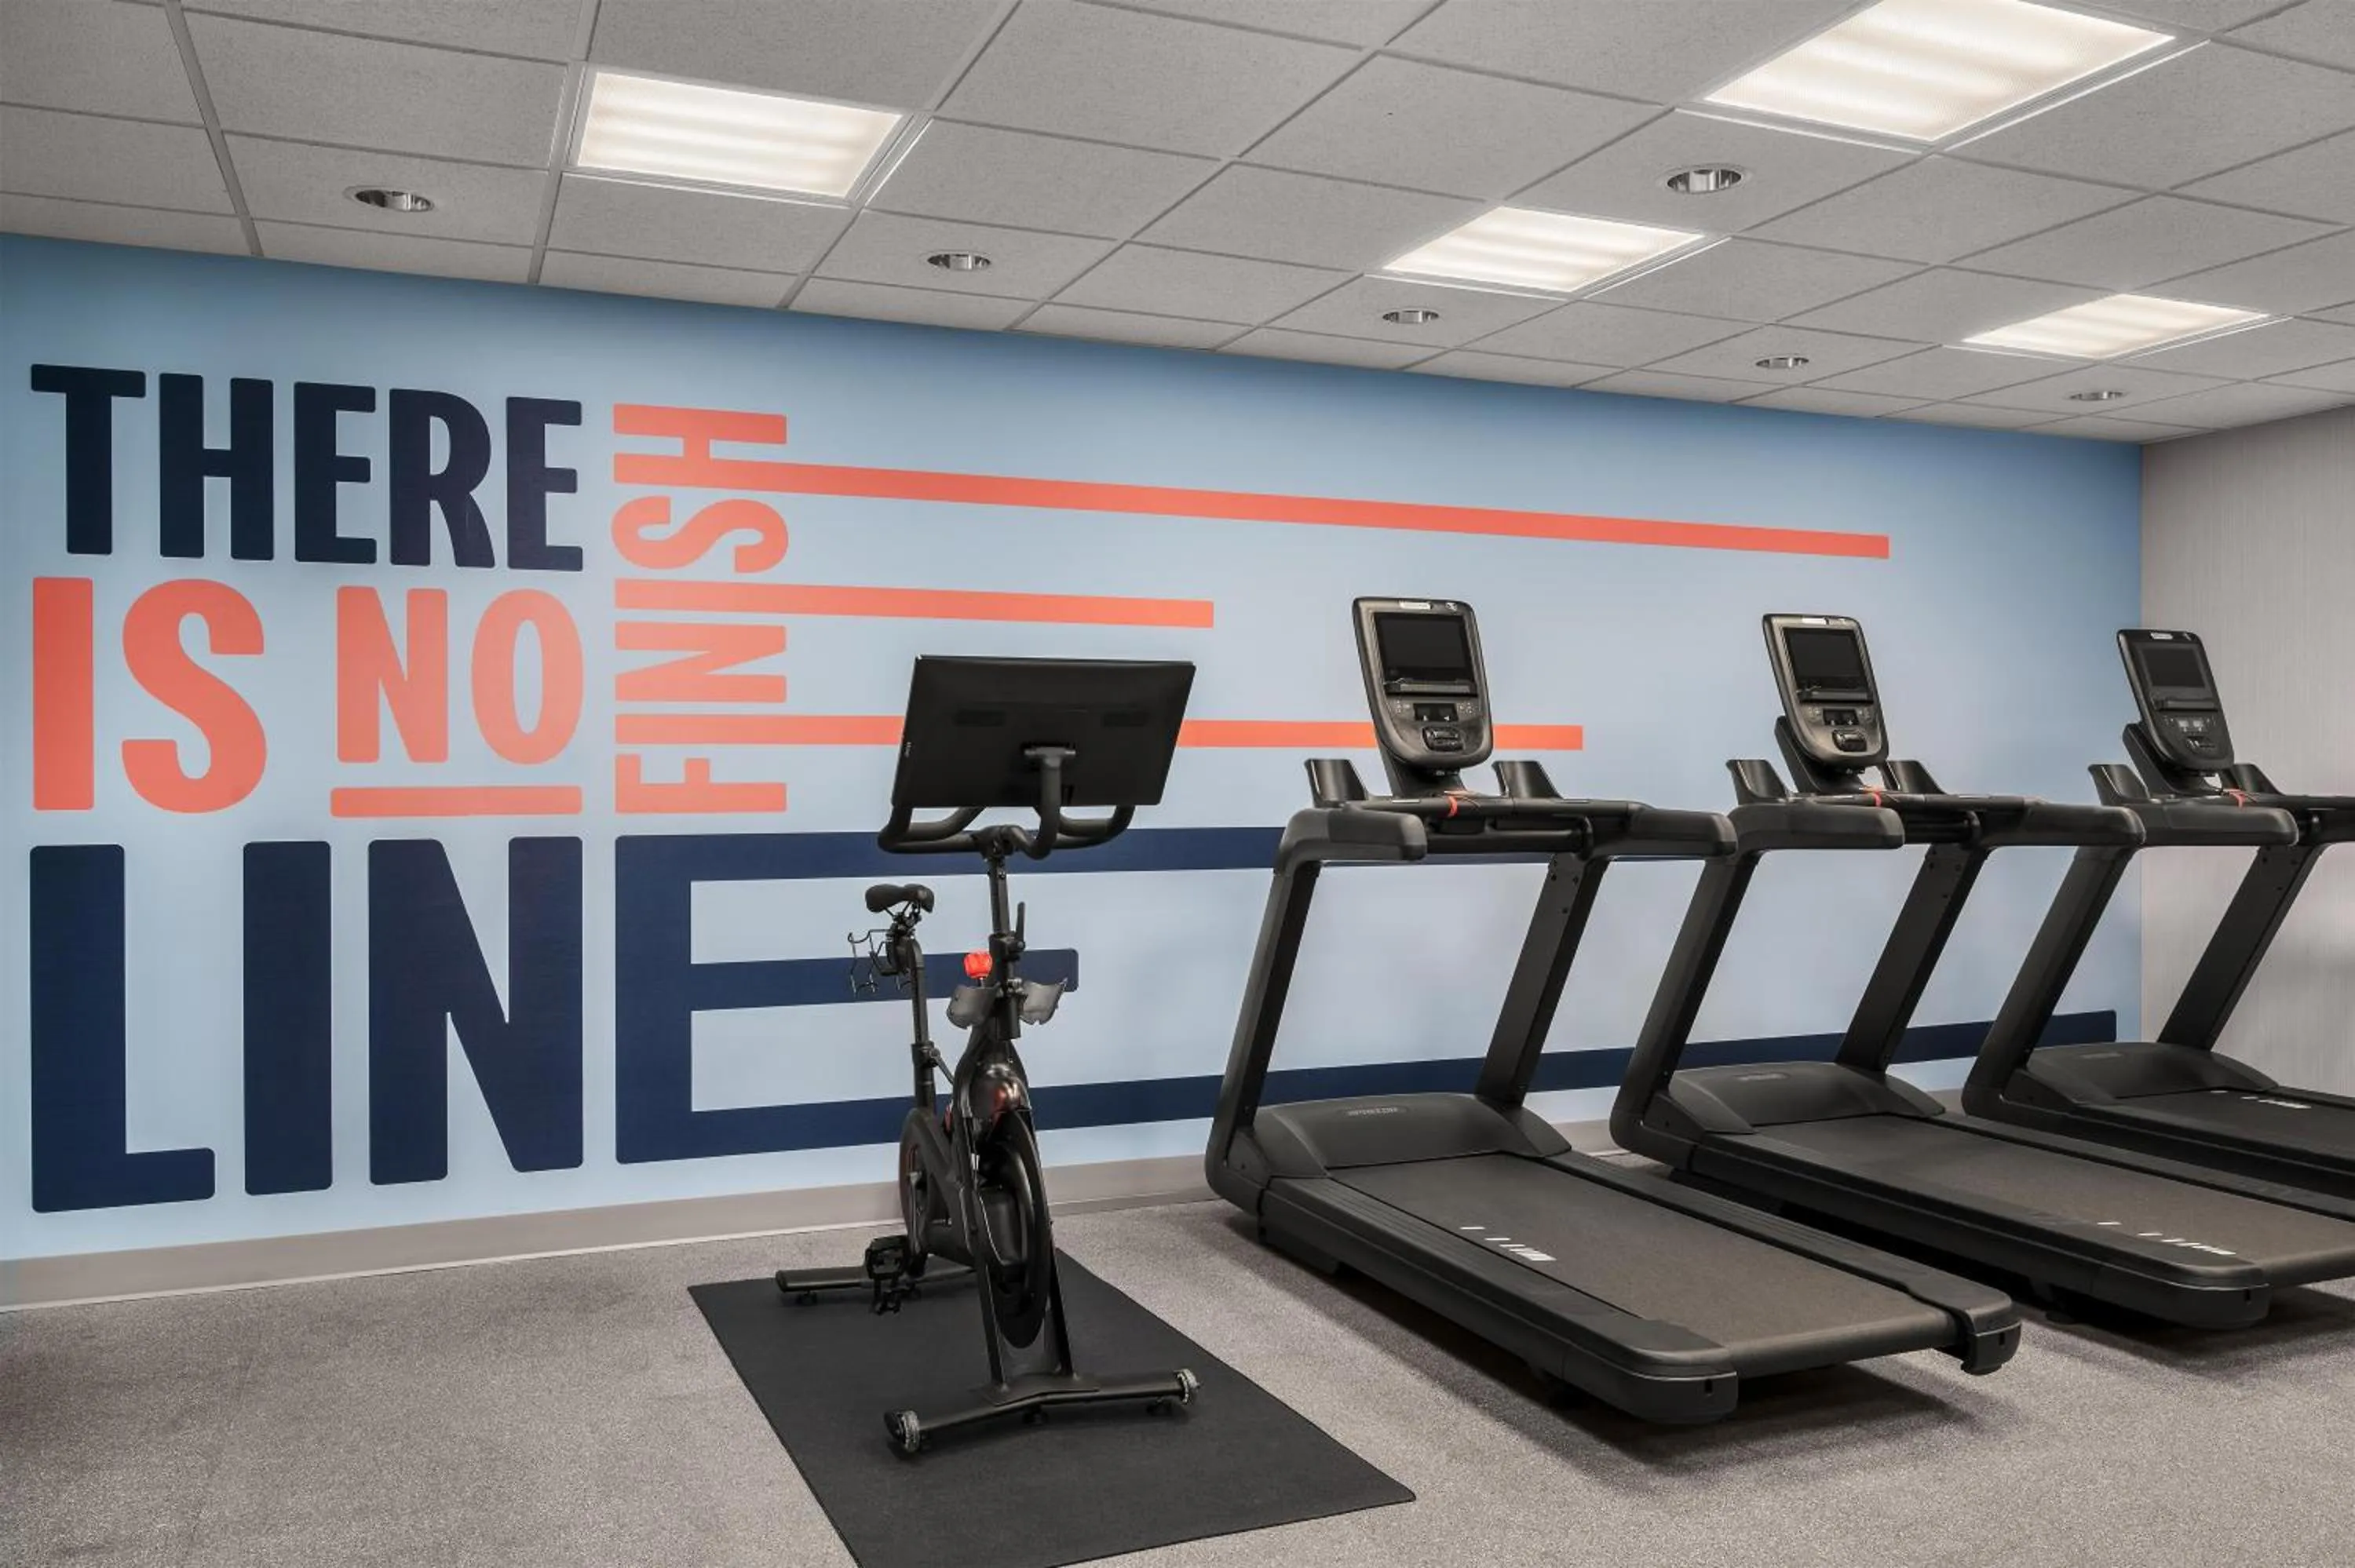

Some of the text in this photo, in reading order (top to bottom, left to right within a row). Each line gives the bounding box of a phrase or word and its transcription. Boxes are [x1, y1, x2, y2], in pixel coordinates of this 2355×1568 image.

[30, 363, 583, 572] THERE
[33, 578, 582, 814] IS NO
[613, 404, 788, 814] FINISH
